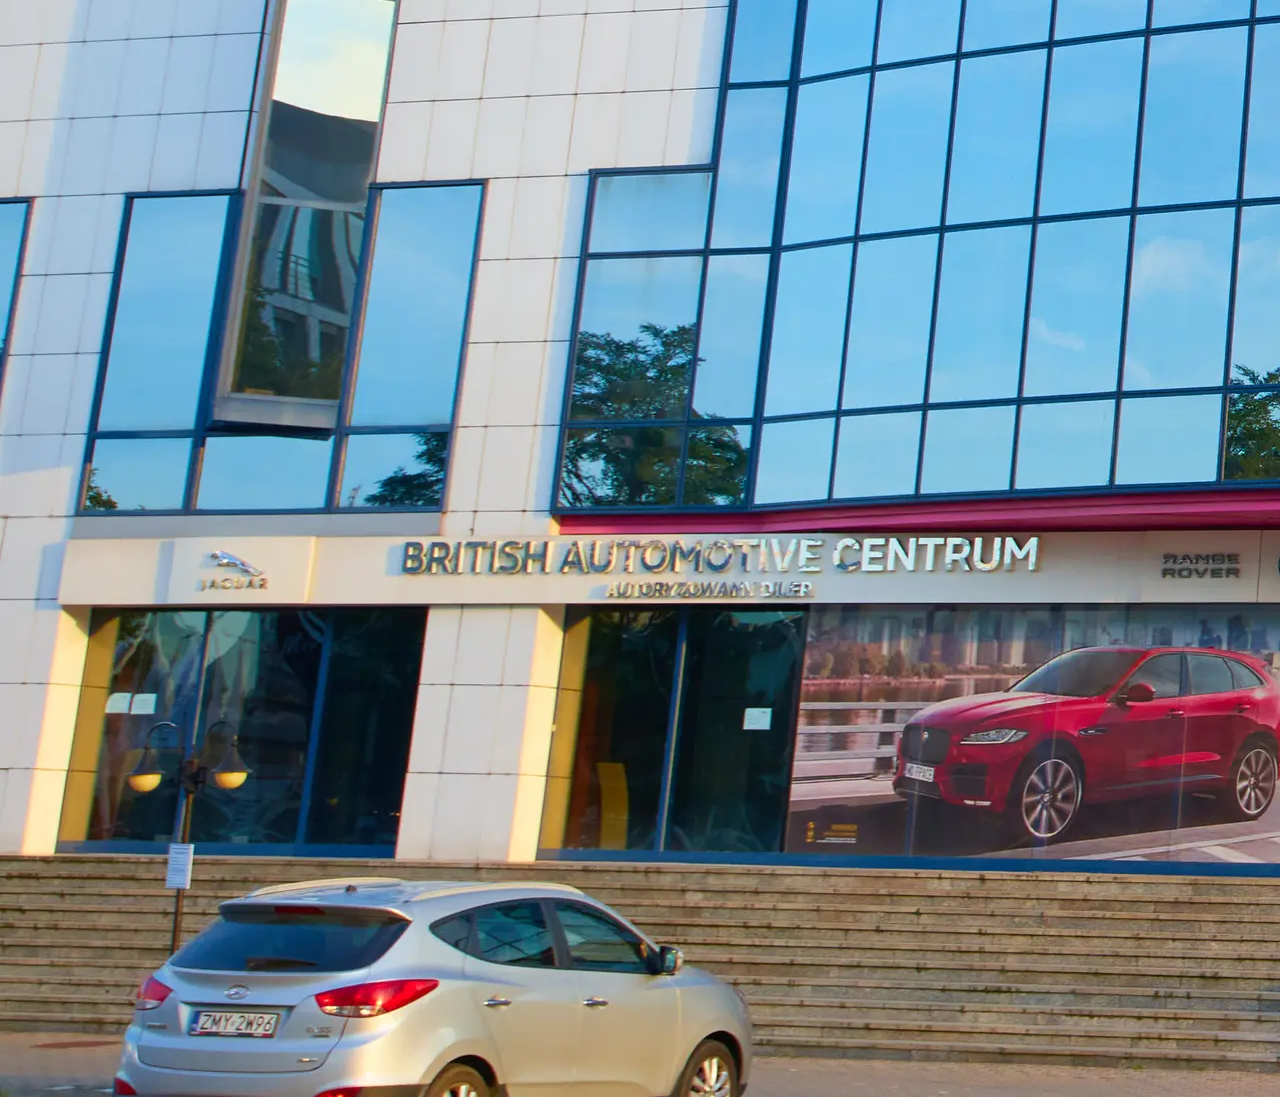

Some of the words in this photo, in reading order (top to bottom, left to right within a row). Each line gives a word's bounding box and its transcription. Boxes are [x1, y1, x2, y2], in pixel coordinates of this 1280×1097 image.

[402, 540, 551, 574] BRITISH
[559, 537, 824, 574] AUTOMOTIVE
[832, 536, 1039, 573] CENTRUM
[1162, 553, 1240, 565] RANGE
[1162, 567, 1241, 579] ROVER
[200, 577, 269, 592] JAGUAR
[760, 581, 814, 599] DILER
